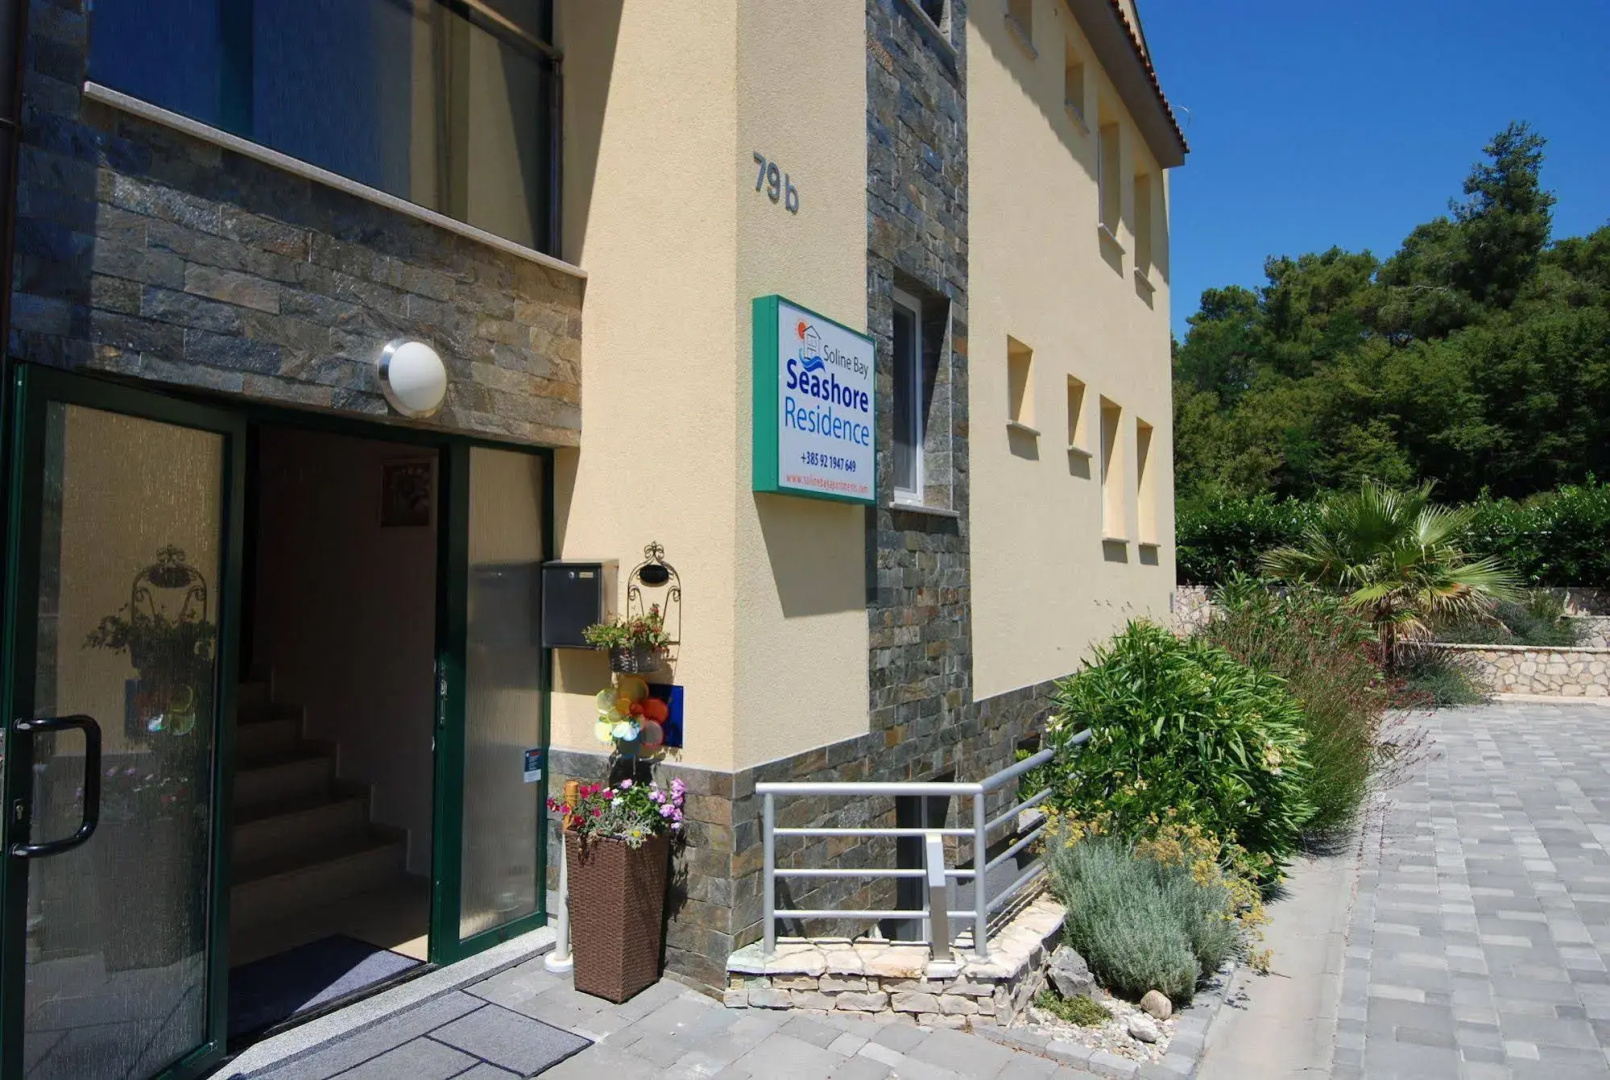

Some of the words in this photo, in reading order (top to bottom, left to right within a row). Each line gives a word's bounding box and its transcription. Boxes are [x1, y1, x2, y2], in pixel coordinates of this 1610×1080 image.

[824, 345, 852, 369] Soline
[854, 357, 869, 380] Bay
[787, 358, 869, 413] Seashore
[785, 396, 870, 446] Residence
[801, 451, 819, 467] +385
[820, 454, 828, 468] 92
[830, 456, 844, 471] 1947
[845, 459, 856, 472] 649
